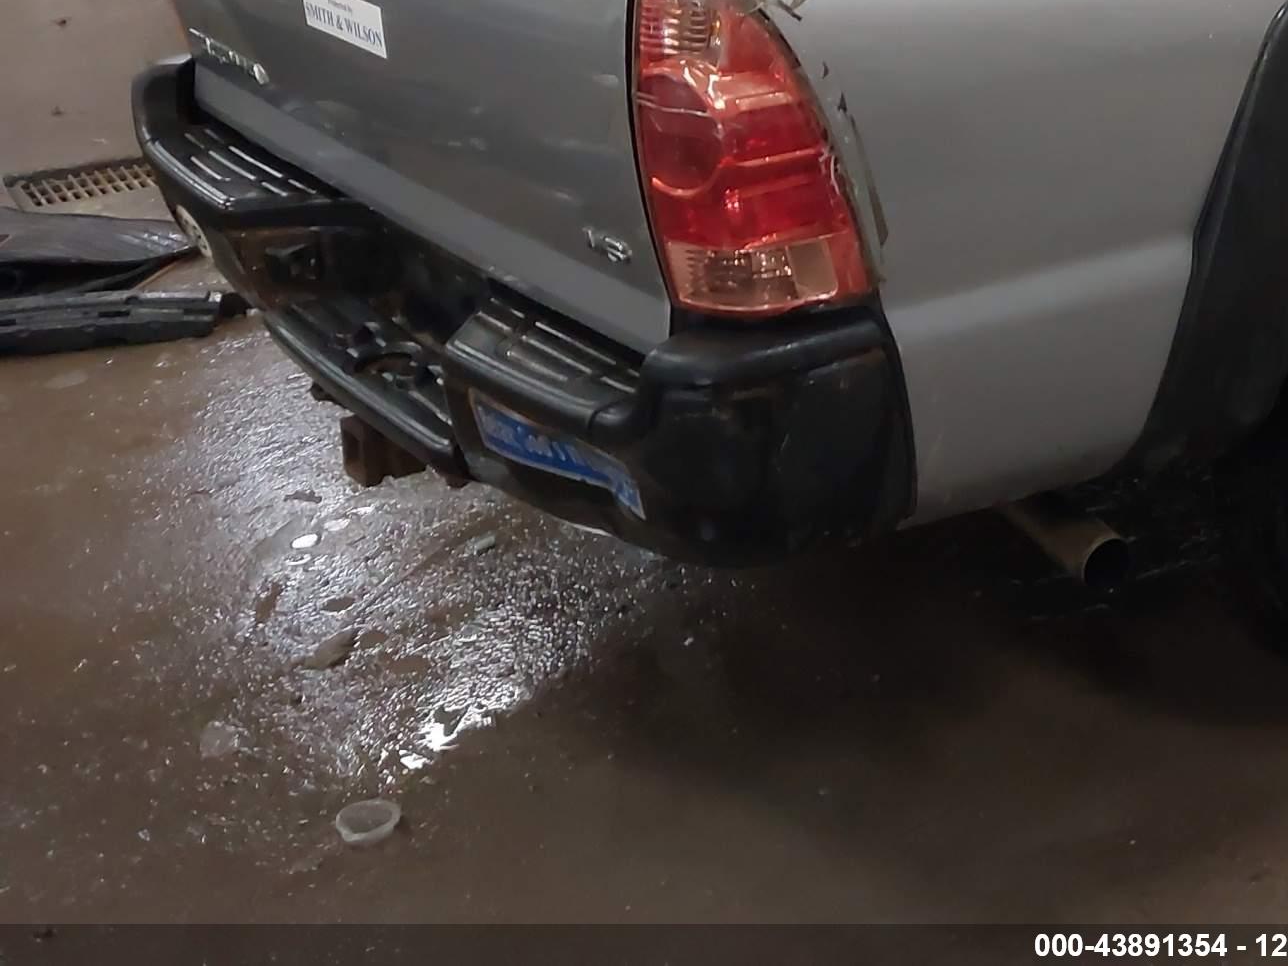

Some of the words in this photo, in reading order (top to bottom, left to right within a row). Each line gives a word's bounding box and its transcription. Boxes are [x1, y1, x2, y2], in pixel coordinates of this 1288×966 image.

[306, 1, 334, 27] SMITH
[335, 14, 344, 31] &
[344, 17, 383, 49] WILSON
